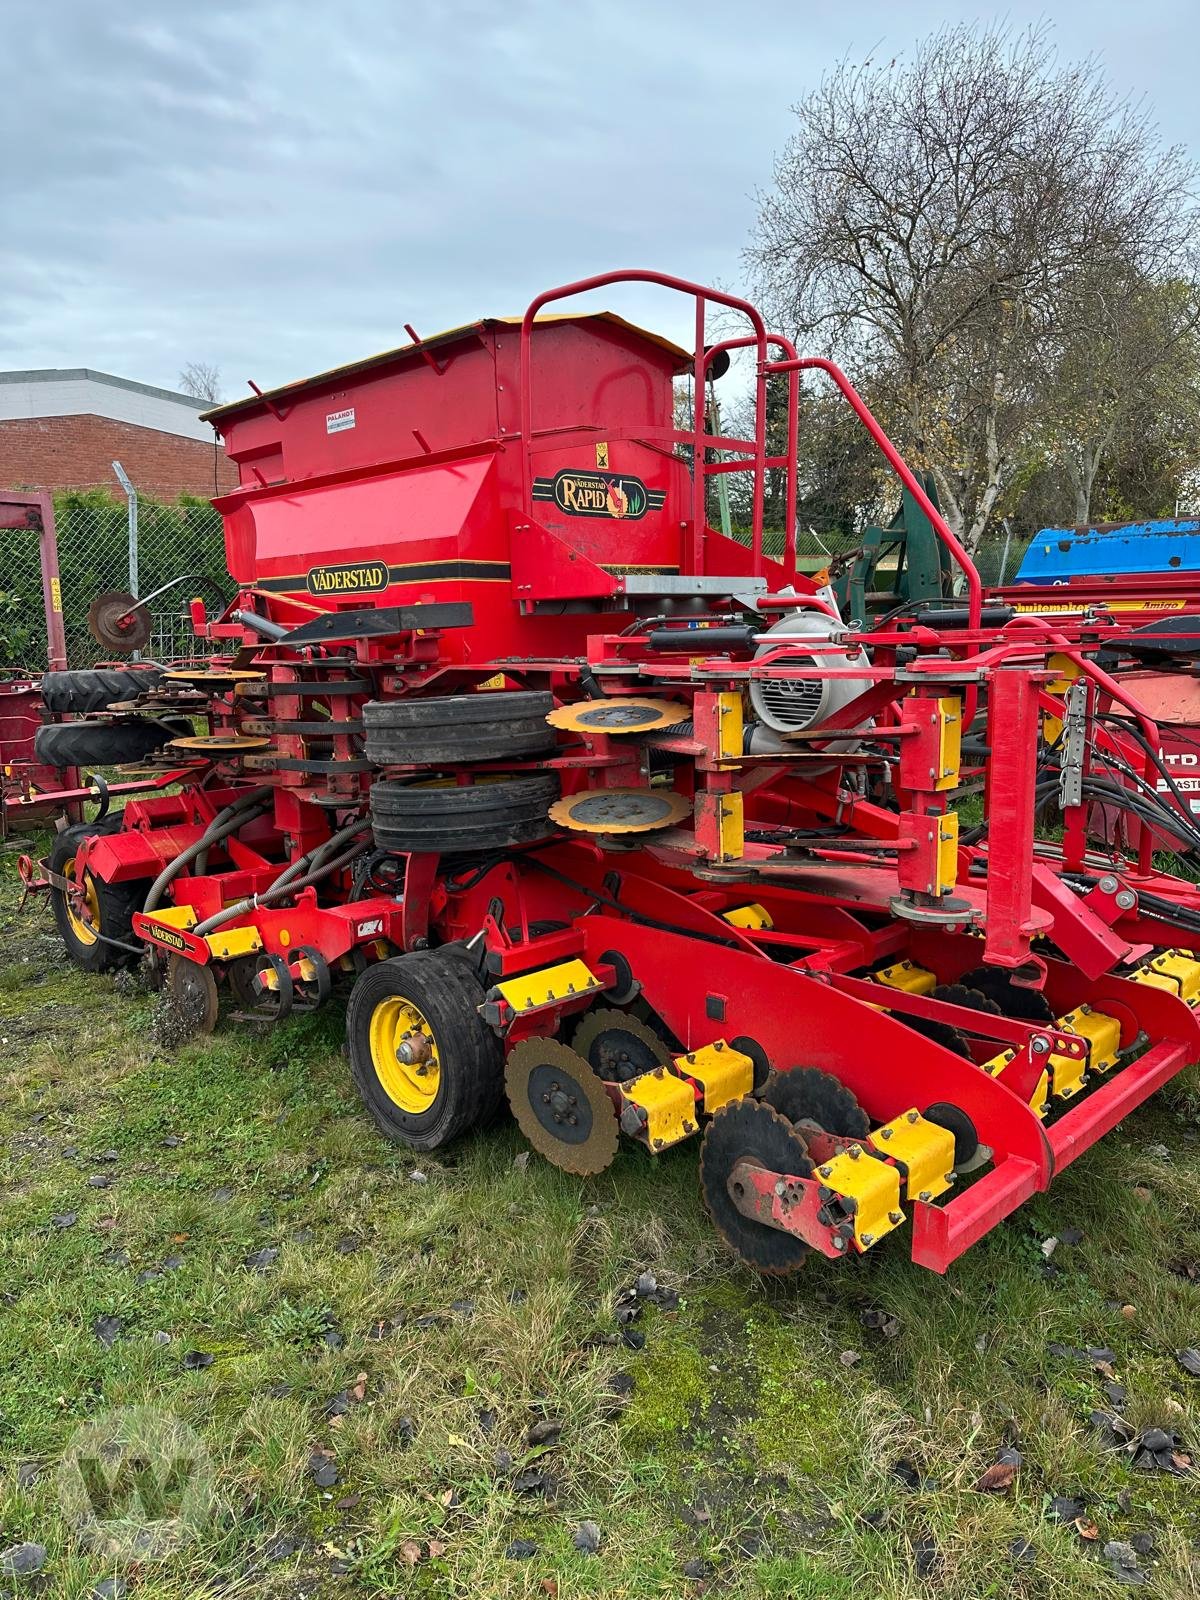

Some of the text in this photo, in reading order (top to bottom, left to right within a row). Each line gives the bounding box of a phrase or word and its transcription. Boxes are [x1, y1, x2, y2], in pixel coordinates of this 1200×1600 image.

[562, 478, 606, 509] RAPID
[574, 478, 606, 490] VÄDERSTAD
[311, 568, 383, 590] VÄDERSTAD
[1142, 601, 1179, 609] Amigo
[152, 924, 183, 948] VÄDERSTAD
